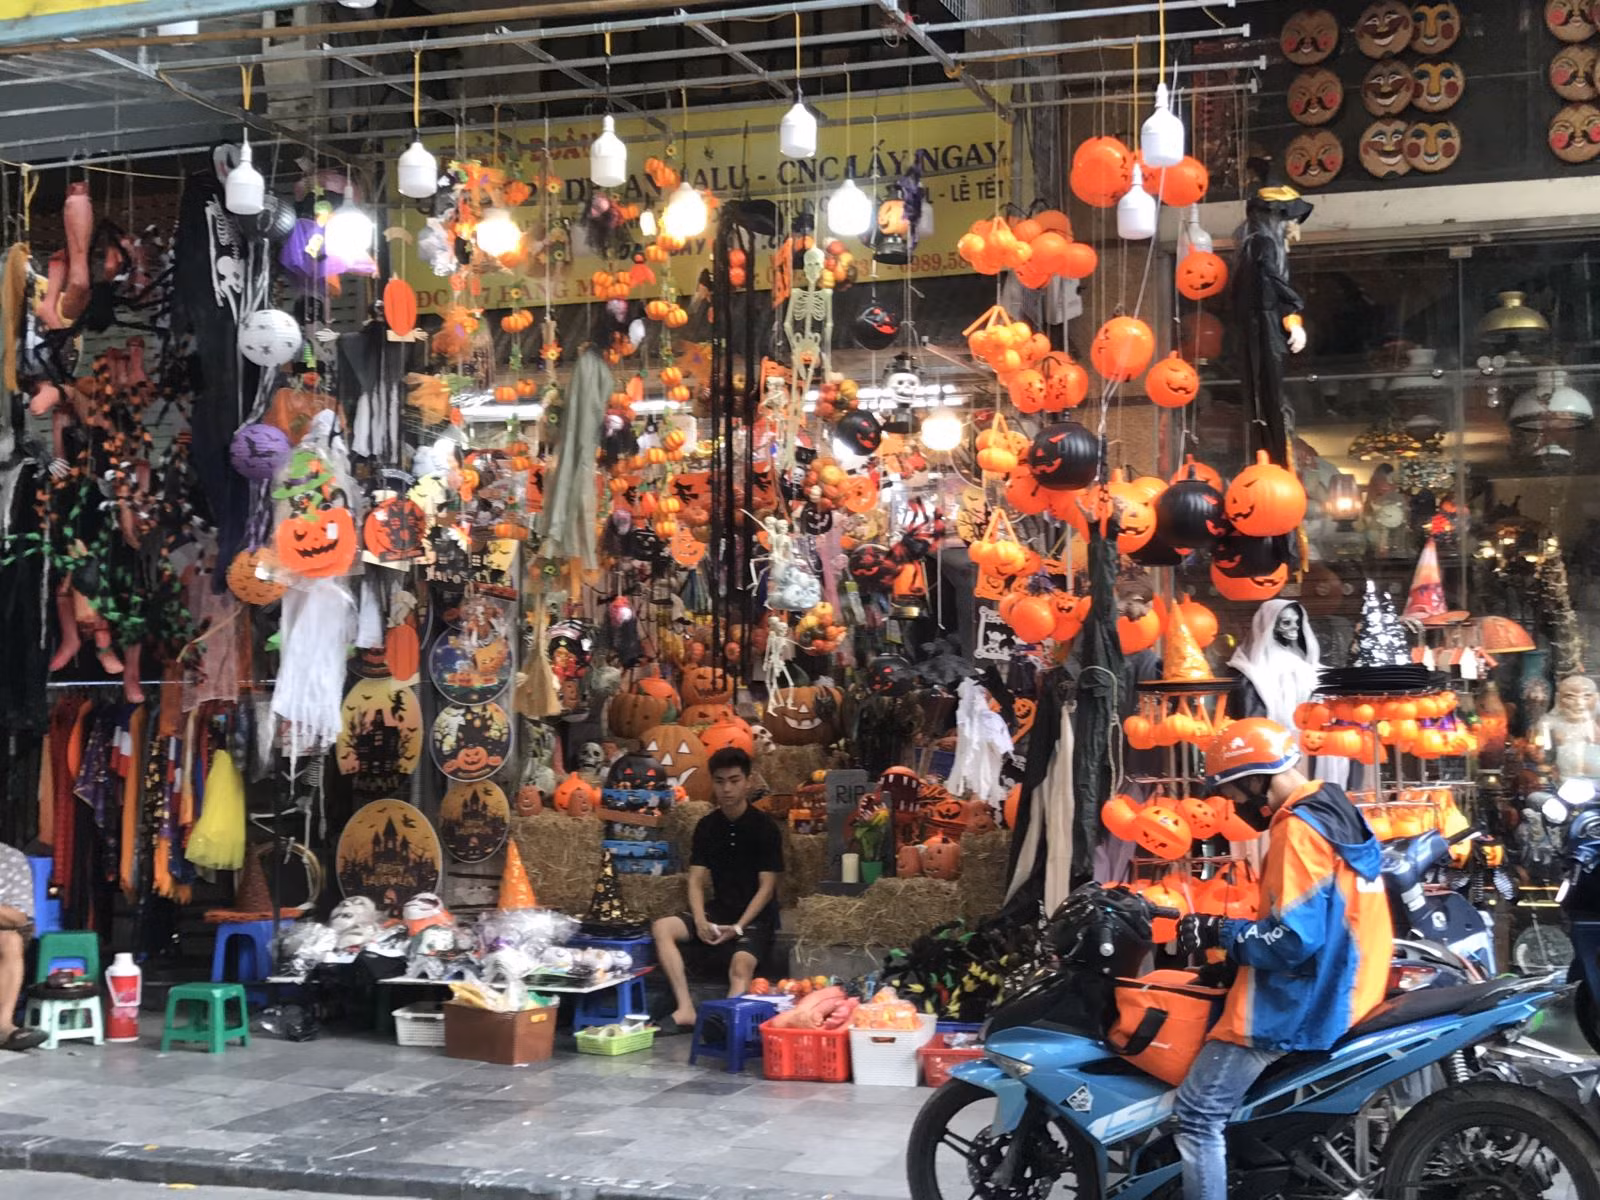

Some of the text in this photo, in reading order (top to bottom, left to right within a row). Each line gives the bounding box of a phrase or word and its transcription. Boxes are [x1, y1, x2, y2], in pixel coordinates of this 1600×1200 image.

[694, 164, 749, 193] ALU
[777, 156, 839, 186] CNC
[914, 141, 1006, 171] NGAY
[836, 784, 866, 804] RIP
